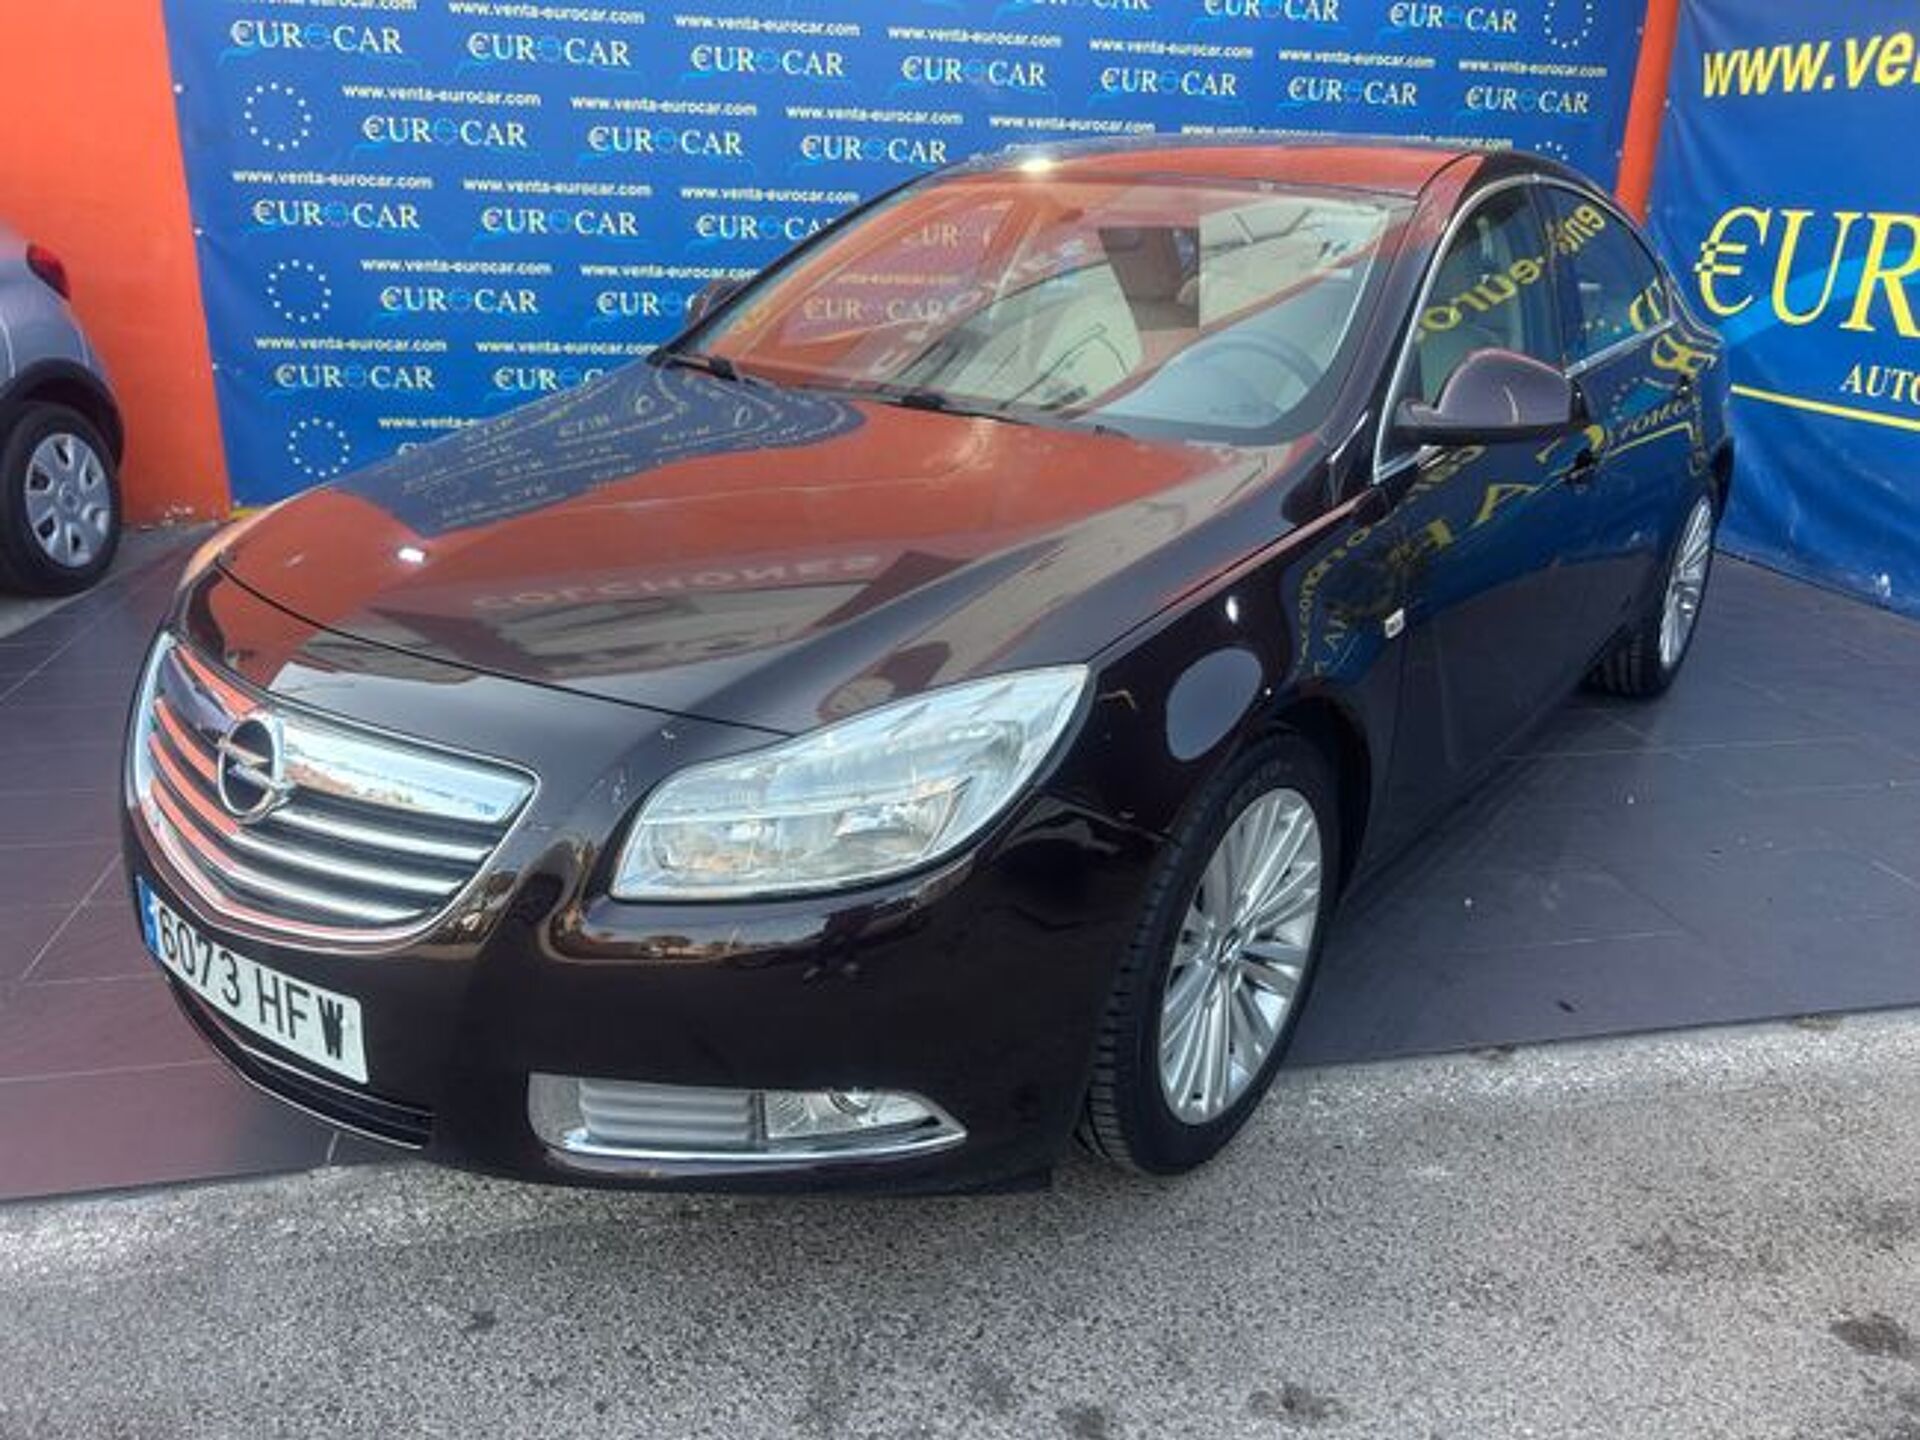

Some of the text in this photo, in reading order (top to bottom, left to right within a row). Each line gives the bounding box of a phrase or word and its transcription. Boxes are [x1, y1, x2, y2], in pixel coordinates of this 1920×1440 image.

[449, 1, 645, 24] www.venta-eurocar.com
[674, 14, 860, 36] www.venta-eurocar.com
[888, 25, 1062, 48] www.venta-eurocar.com
[1089, 38, 1254, 59] www.venta-eurocar.com
[1278, 49, 1436, 70] www.venta-eurocar.com
[1458, 59, 1608, 78] www.venta-eurocar.com
[1703, 31, 1920, 97] www.ve
[342, 83, 541, 107] www.venta-eurocar.com
[569, 96, 757, 117] www.venta-eurocar.com
[785, 104, 964, 126] www.venta-eurocar.com
[989, 115, 1155, 133] www.venta-eurocar.com
[232, 170, 434, 190] www.venta-eurocar.com
[462, 177, 653, 197] www.venta-eurocar.com
[681, 186, 859, 203] www.venta-eurocar.com
[360, 259, 553, 276] www.venta-eurocar.com
[254, 336, 448, 353] www.venta-eurocar.com
[158, 905, 345, 1061] 6073 HFW
